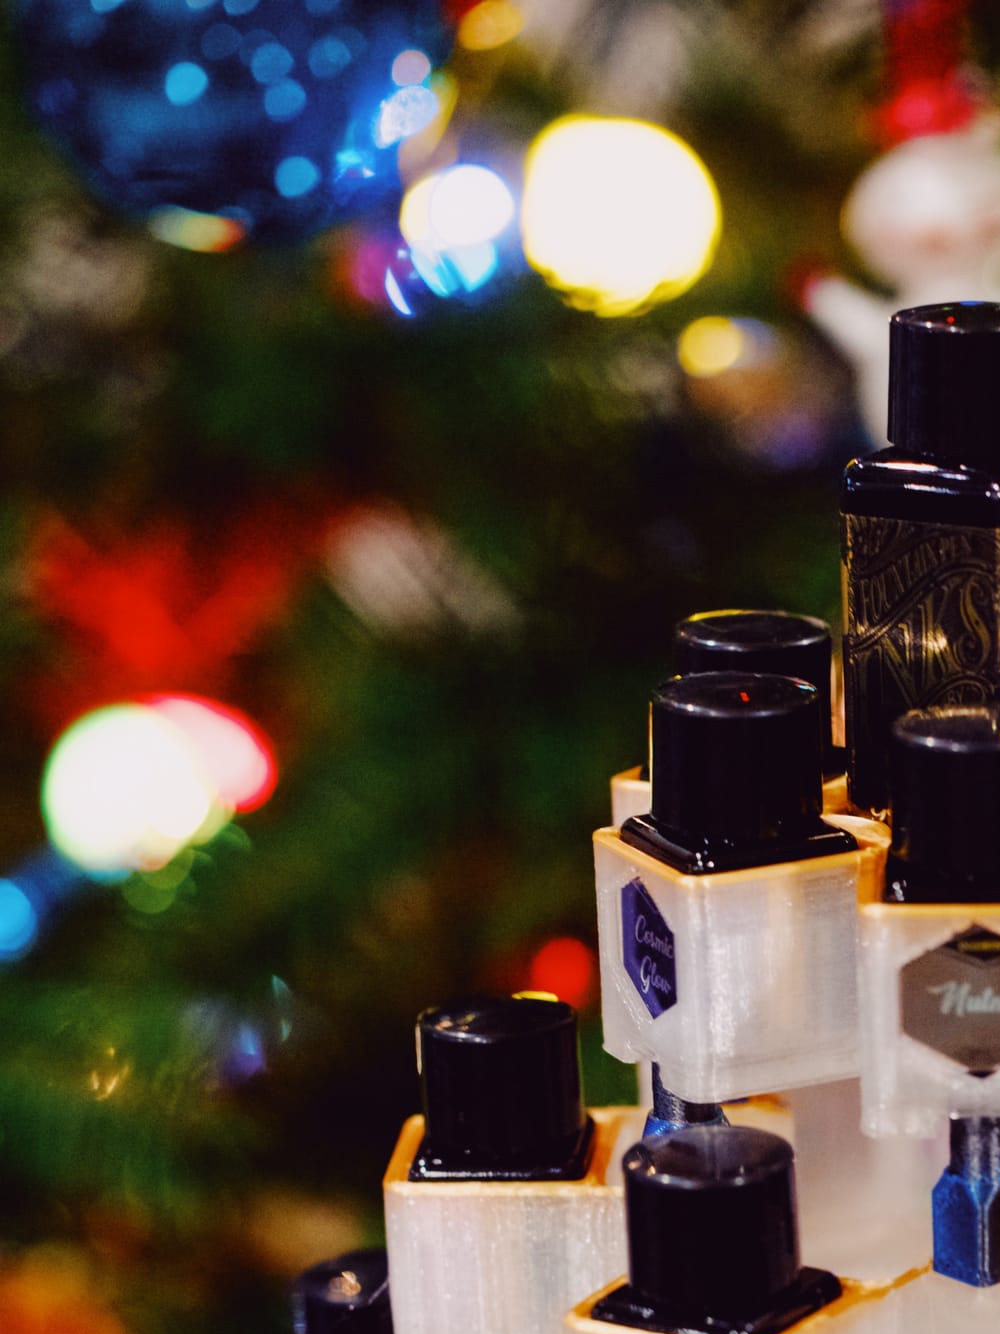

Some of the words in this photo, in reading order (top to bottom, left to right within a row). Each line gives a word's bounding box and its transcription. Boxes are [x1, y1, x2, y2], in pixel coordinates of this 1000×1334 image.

[859, 542, 938, 632] FOUNTAIN
[635, 915, 673, 959] Cosmic
[640, 956, 671, 994] Glow
